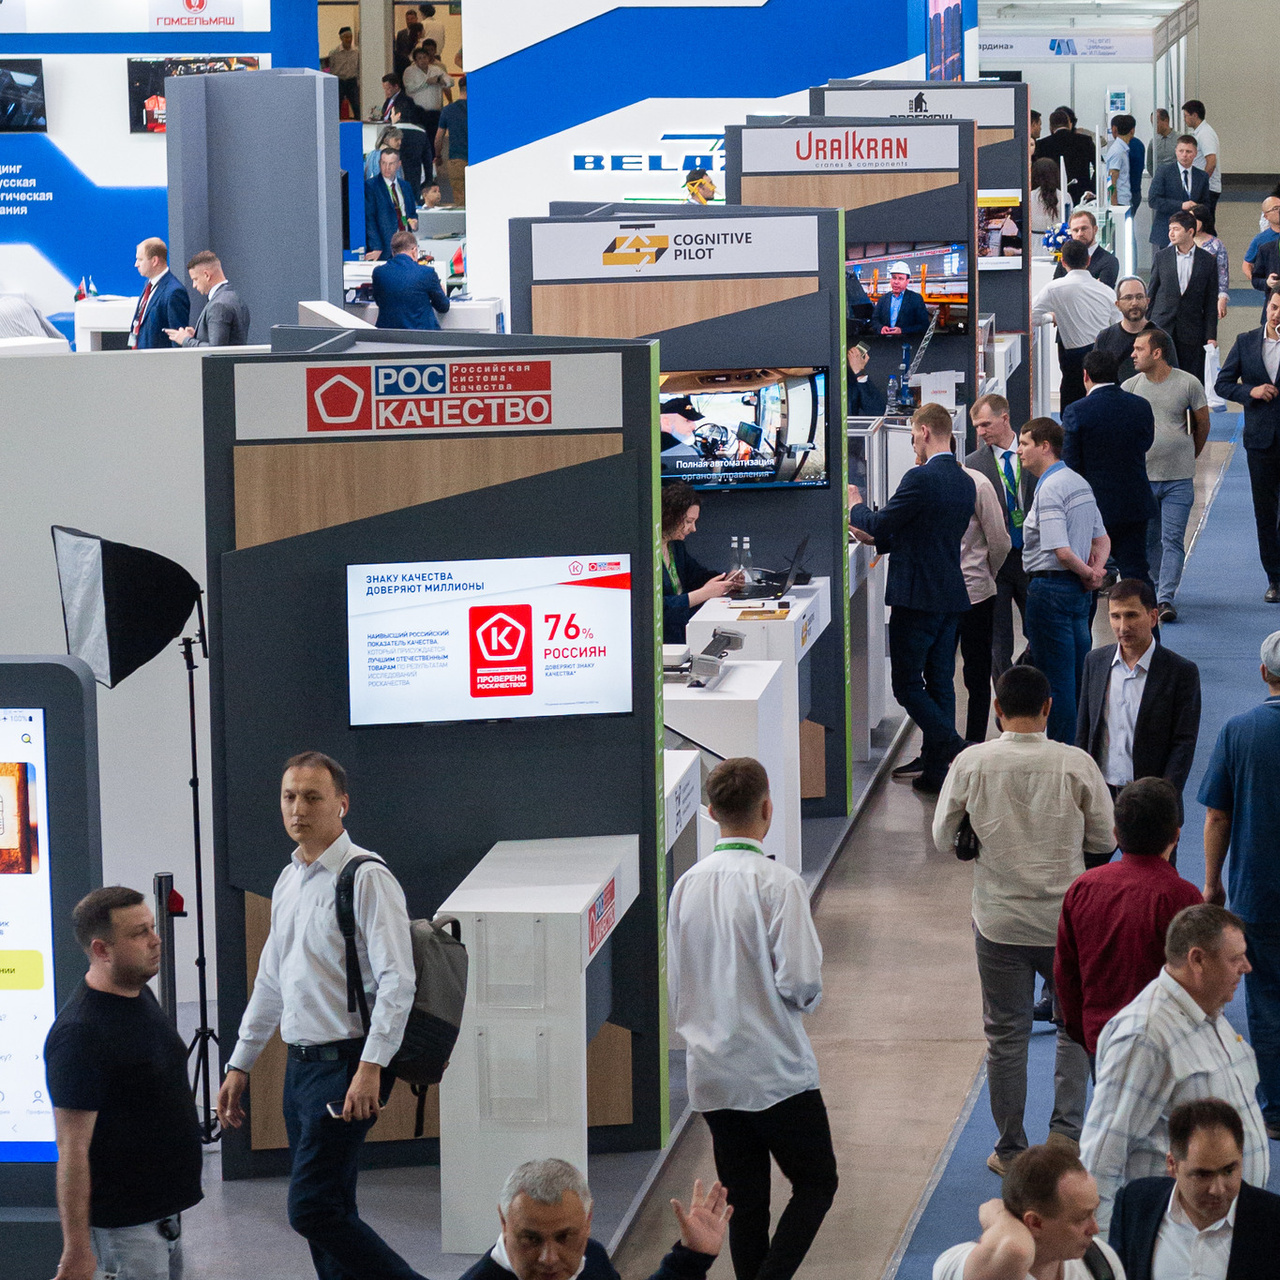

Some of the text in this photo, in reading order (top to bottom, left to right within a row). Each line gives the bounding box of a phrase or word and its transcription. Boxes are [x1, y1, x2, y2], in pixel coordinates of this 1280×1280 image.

[156, 16, 235, 27] ГОМСЕЛЬМАШ
[573, 155, 726, 171] BELA
[857, 161, 908, 169] components
[674, 232, 752, 246] COGNITIVE
[674, 248, 714, 260] PILOT
[452, 364, 531, 374] Российская
[378, 366, 444, 394] РОС
[452, 374, 506, 382] система
[452, 383, 513, 392] качества
[378, 396, 550, 427] КАЧЕСТВО
[366, 572, 453, 584] ЗНАКУ КАЧЕСТВА
[366, 582, 485, 596] ДОВЕРЯЮТ МИЛЛИОНЫ
[544, 646, 607, 659] РОССИЯН
[477, 674, 526, 683] ПРОВЕРЕНО
